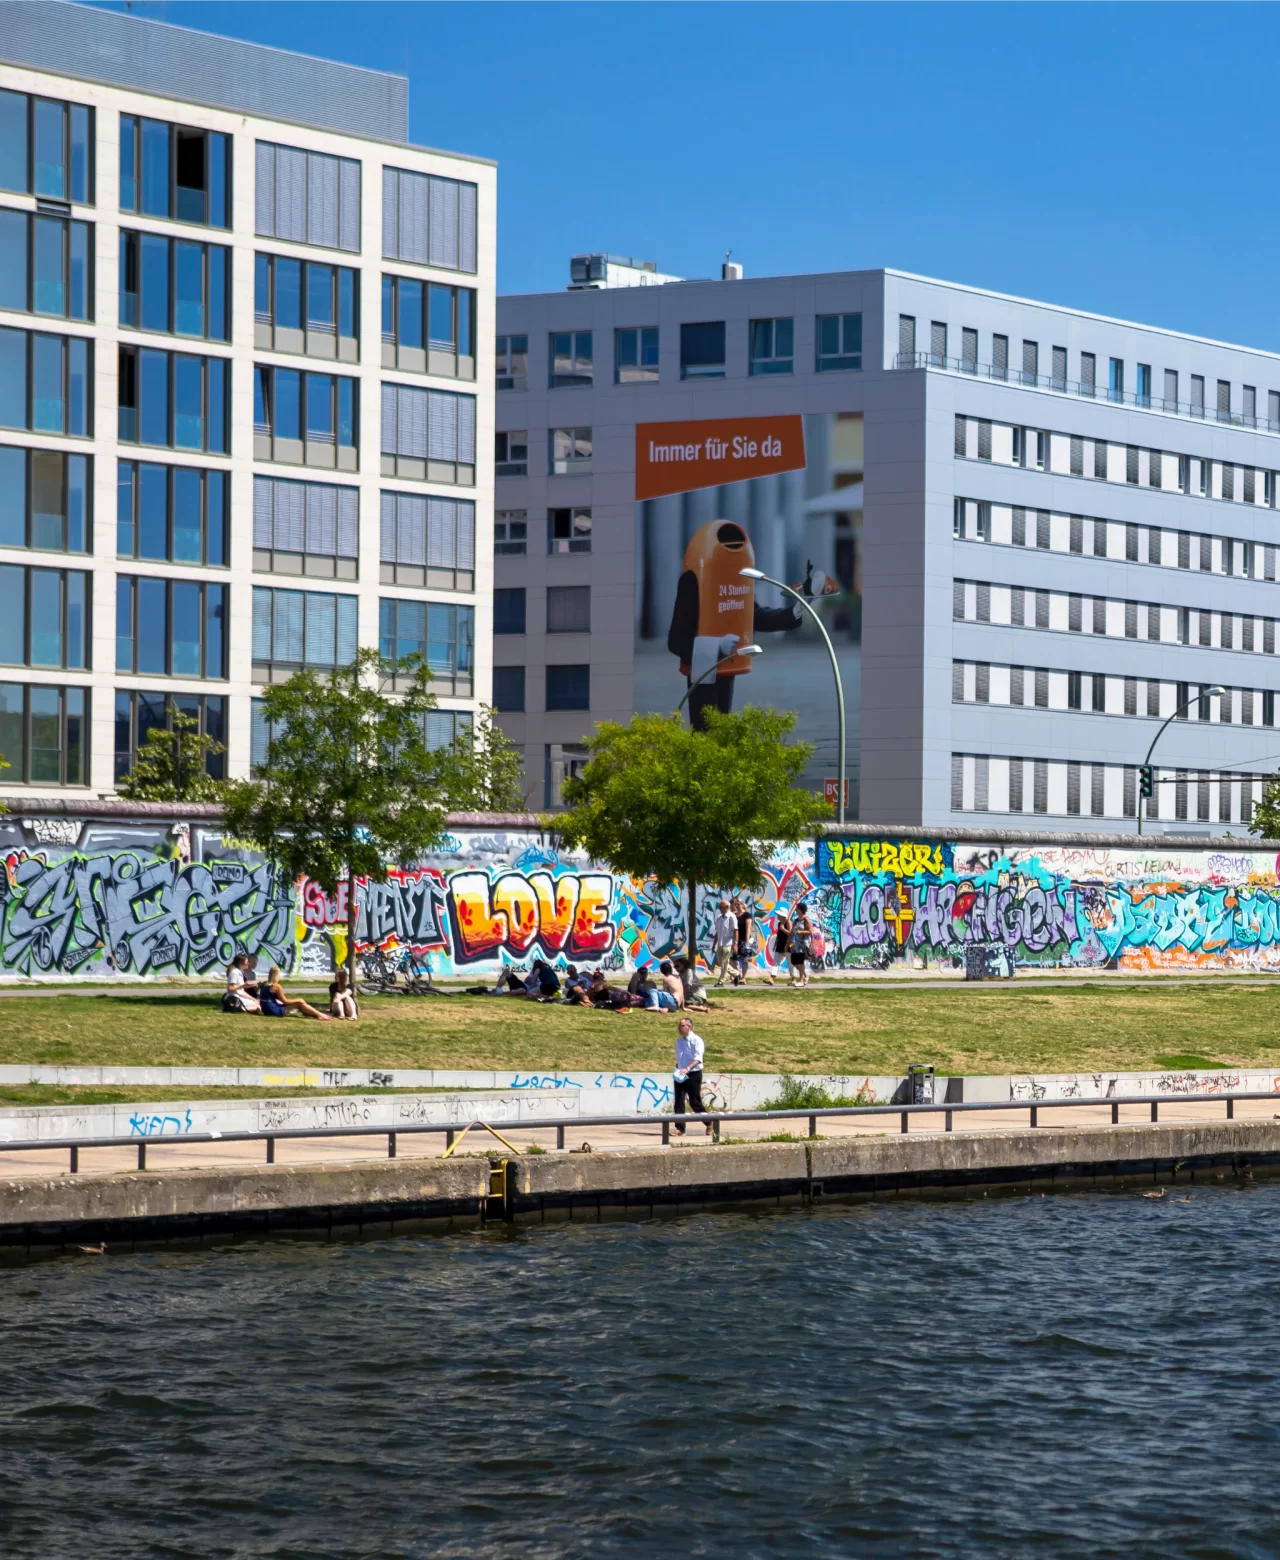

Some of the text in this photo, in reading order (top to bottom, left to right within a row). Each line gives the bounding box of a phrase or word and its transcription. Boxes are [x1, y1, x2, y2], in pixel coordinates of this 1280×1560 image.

[649, 434, 782, 462] Immer für Sie da
[719, 585, 727, 596] 24
[718, 599, 745, 614] geöffnet
[446, 871, 616, 964] LOVE
